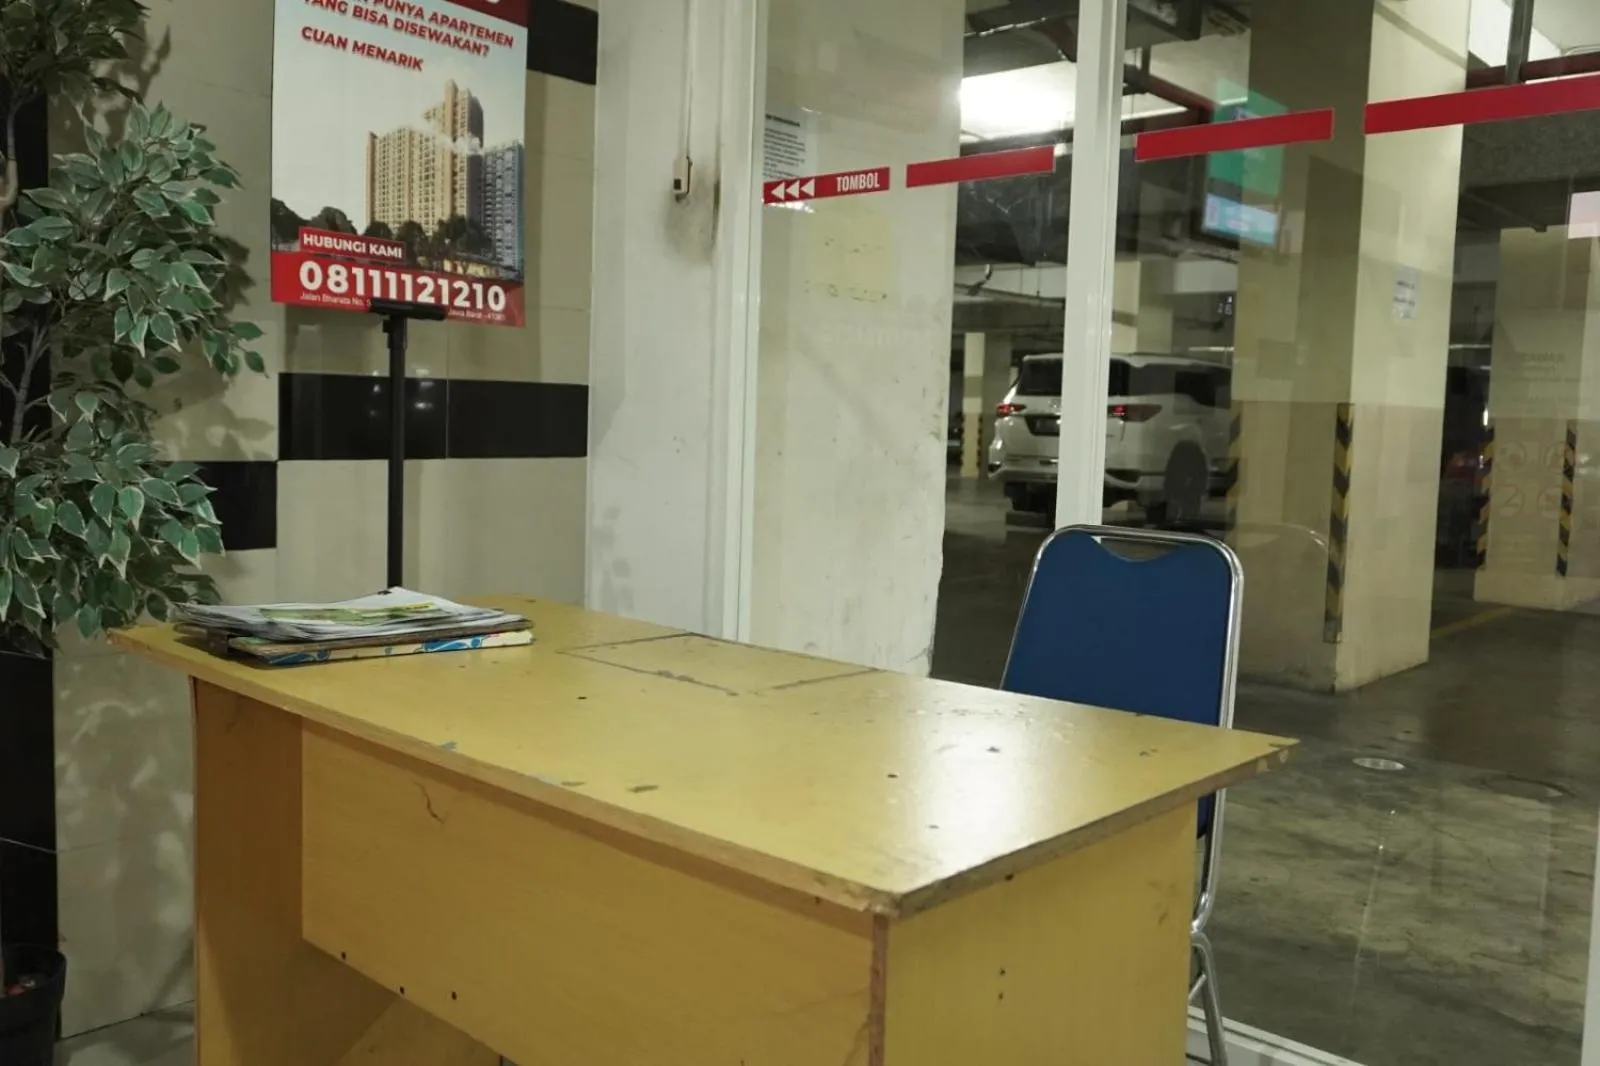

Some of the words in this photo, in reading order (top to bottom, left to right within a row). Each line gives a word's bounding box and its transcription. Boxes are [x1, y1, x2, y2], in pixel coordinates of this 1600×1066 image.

[301, 26, 348, 51] CUAN
[352, 40, 424, 71] MENARIK
[352, 5, 389, 26] BISA
[393, 17, 490, 57] DISEWAKAN?
[428, 11, 514, 49] APARTEMEN
[836, 172, 880, 192] TOMBOL
[303, 233, 366, 253] HUBUNGI
[369, 243, 403, 258] KAMI
[299, 260, 506, 312] 08111121210
